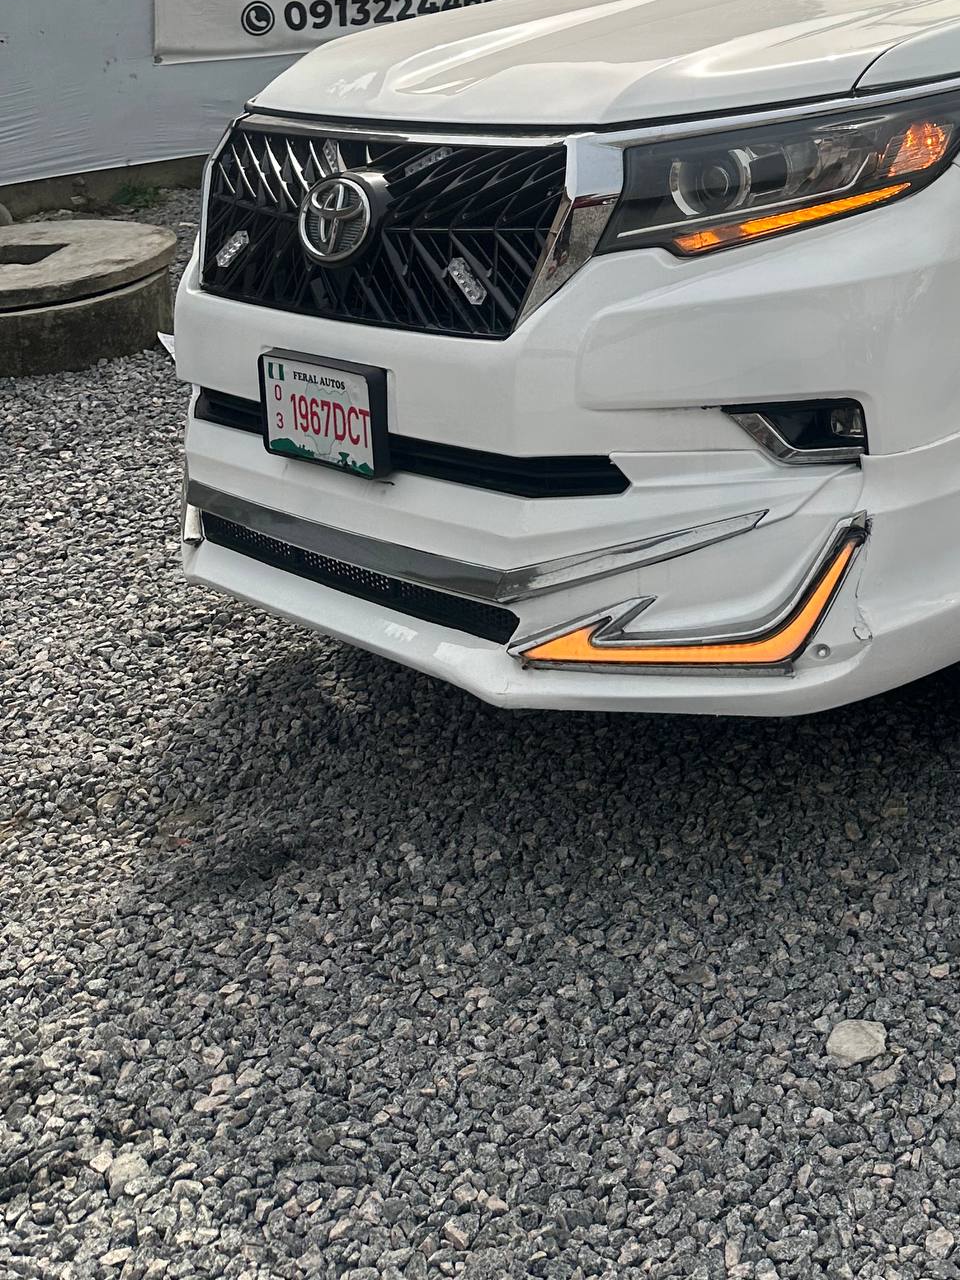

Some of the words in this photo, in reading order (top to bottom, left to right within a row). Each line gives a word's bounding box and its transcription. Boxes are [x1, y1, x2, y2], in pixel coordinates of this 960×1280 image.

[293, 370, 319, 385] FERAL
[319, 376, 346, 391] AUTOS
[290, 393, 371, 449] 1967DCT
